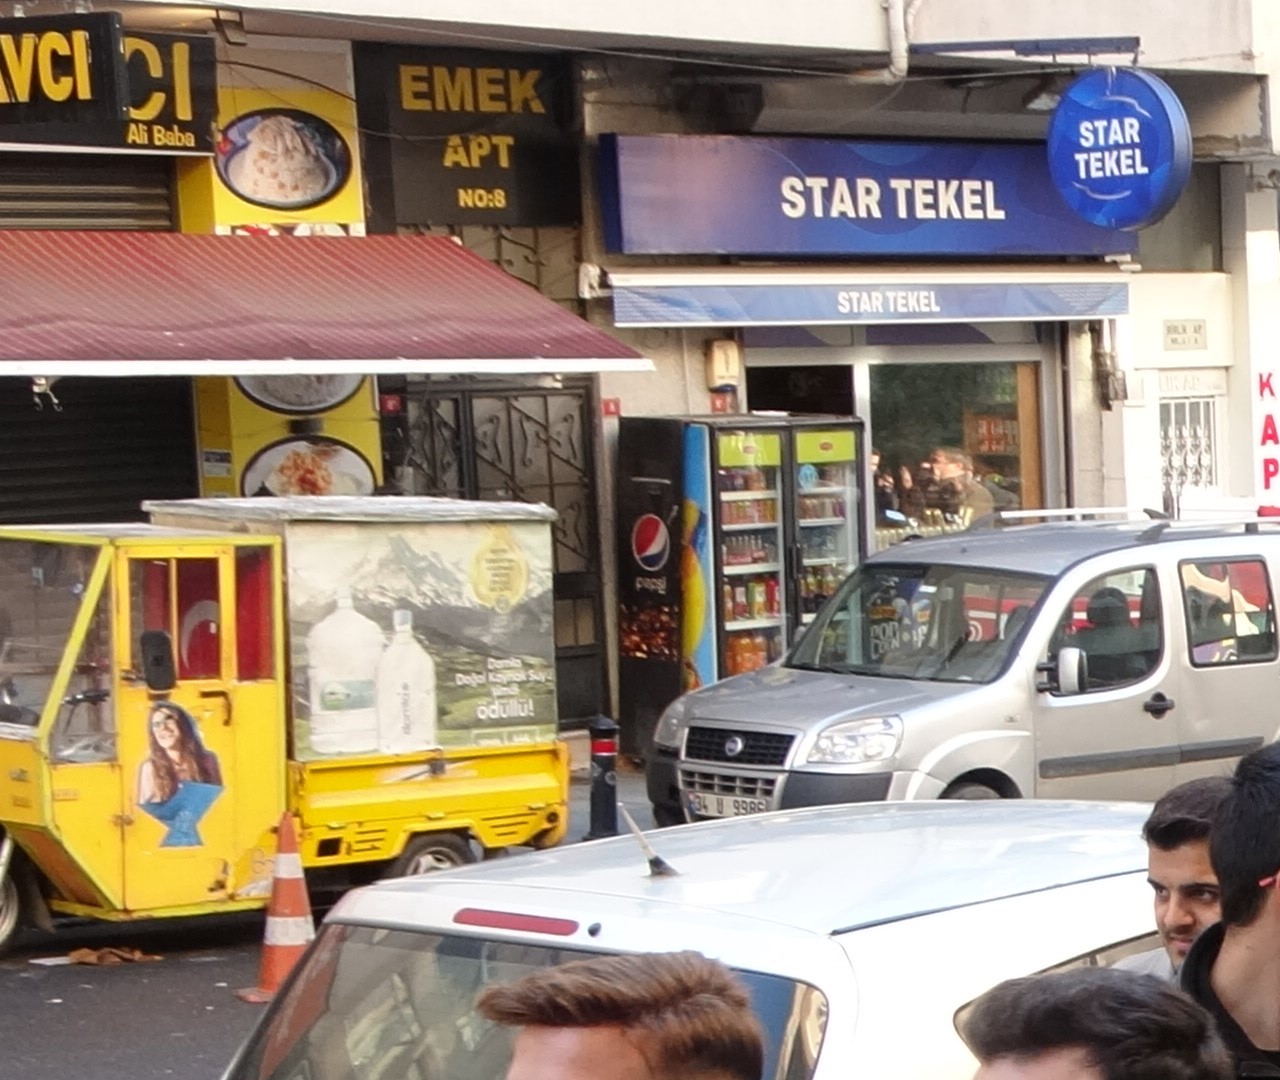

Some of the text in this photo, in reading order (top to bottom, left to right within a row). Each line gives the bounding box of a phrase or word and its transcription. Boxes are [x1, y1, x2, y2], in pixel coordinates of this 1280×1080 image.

[399, 64, 546, 114] EMEK
[127, 123, 196, 148] Ali Baba
[1079, 117, 1141, 147] STAR
[443, 134, 515, 169] APT
[1074, 149, 1149, 180] TEKEL
[457, 187, 507, 209] NO:8
[780, 177, 1006, 221] STAR TEKEL
[837, 290, 941, 314] STAR TEKEL
